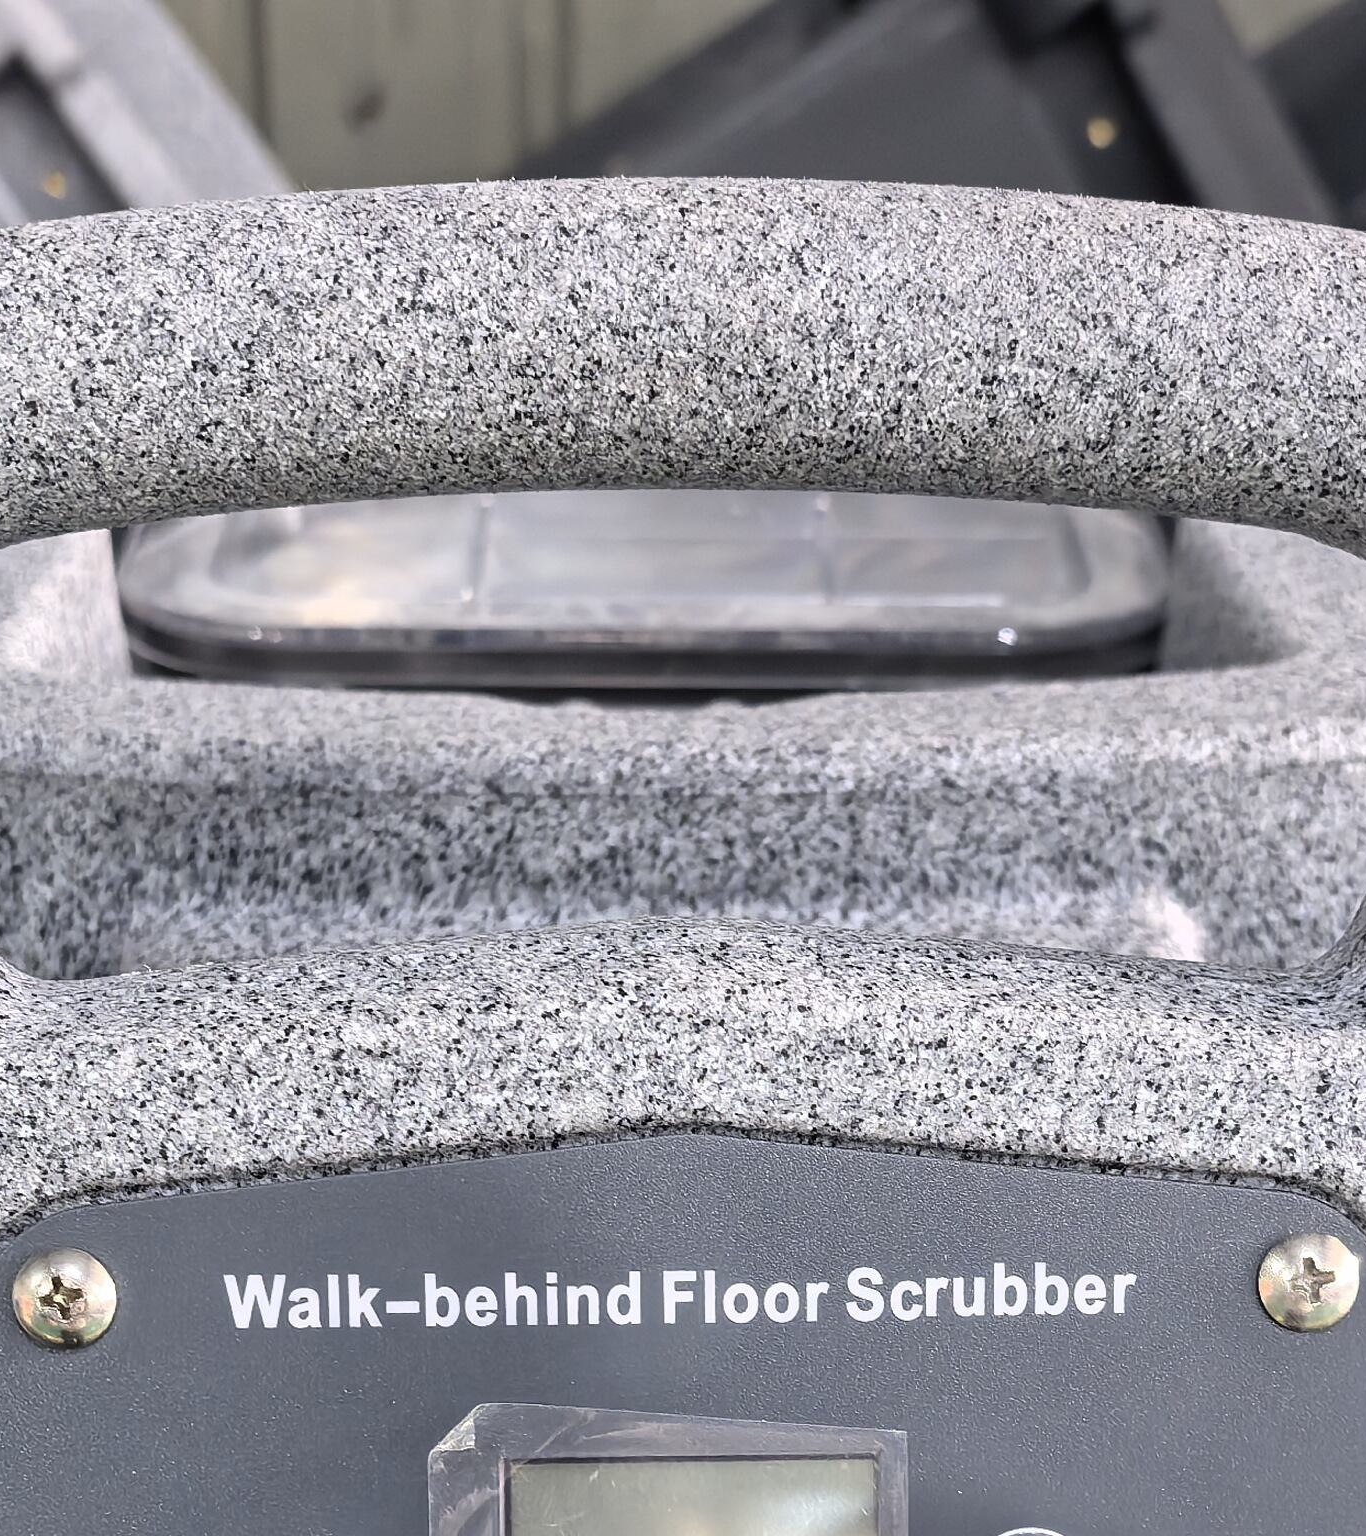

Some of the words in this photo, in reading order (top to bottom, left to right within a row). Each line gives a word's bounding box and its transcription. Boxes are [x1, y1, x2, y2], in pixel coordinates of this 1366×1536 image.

[223, 1270, 641, 1330] Walk-behind
[662, 1269, 830, 1325] Floor
[845, 1262, 1138, 1323] Scrubber
